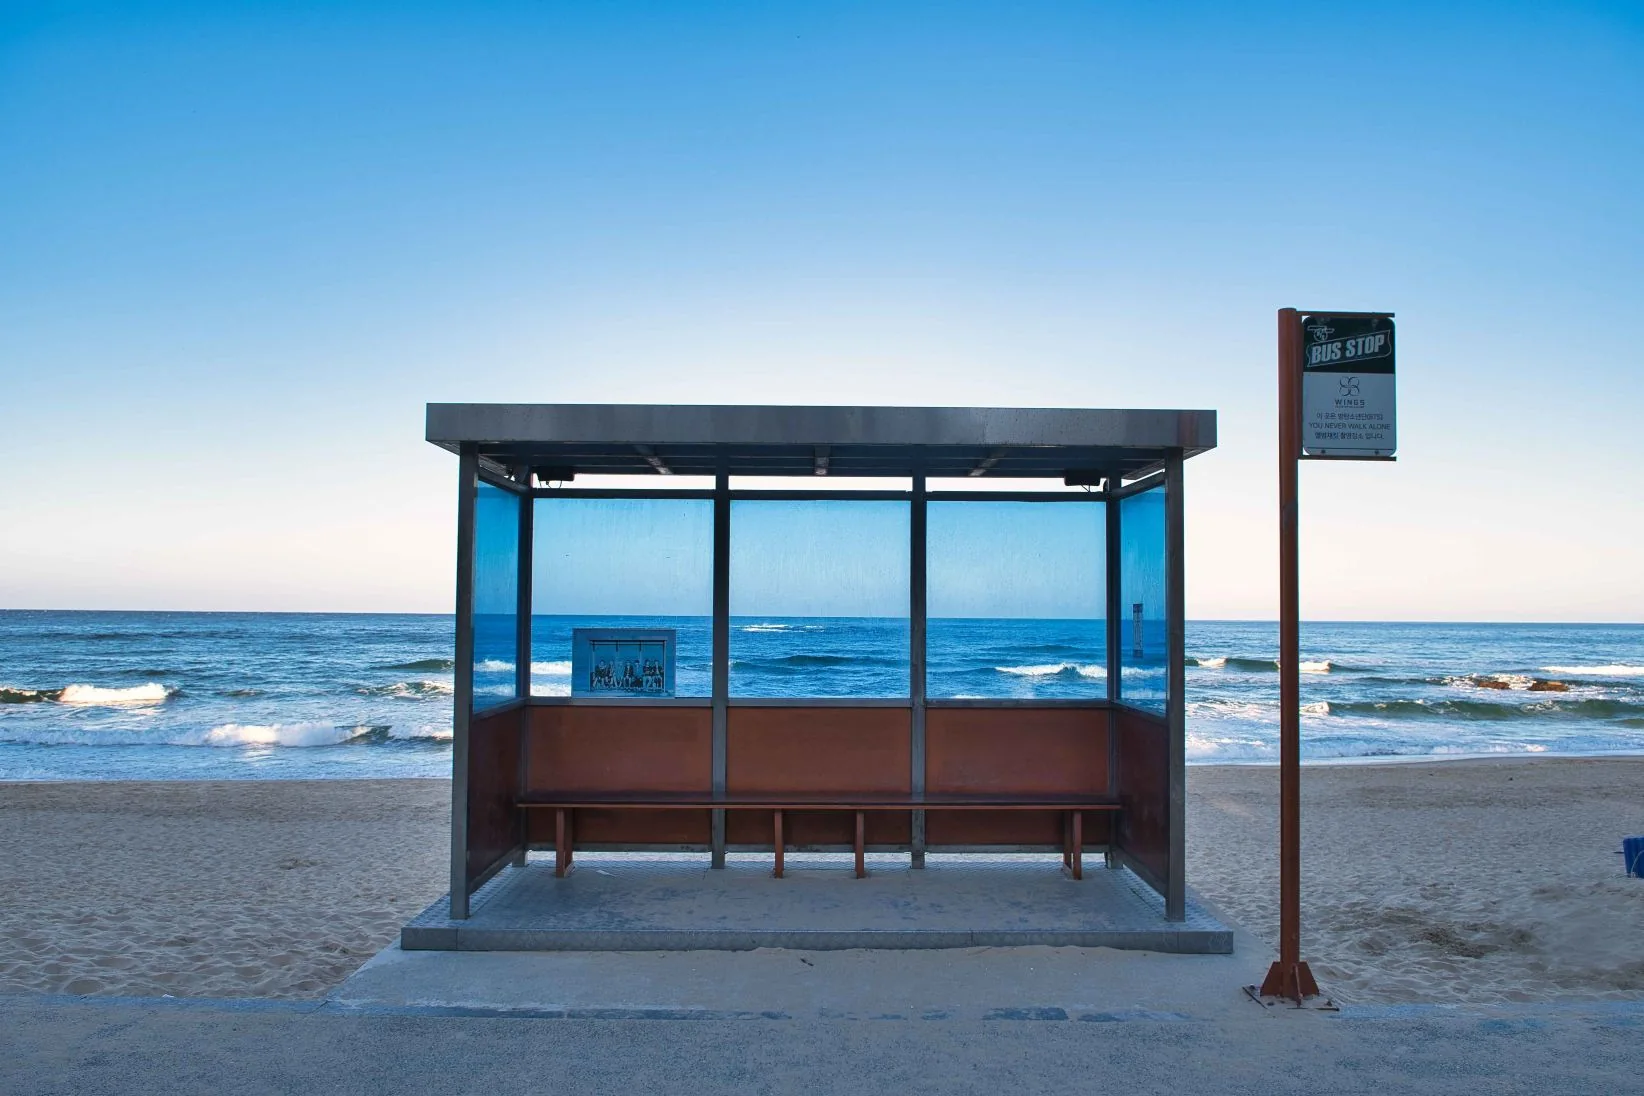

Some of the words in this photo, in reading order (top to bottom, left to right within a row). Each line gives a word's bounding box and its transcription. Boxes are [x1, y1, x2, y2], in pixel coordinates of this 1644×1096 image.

[1311, 342, 1342, 364] BUS
[1345, 334, 1385, 358] STOP
[1309, 422, 1323, 430] YOU
[1324, 422, 1347, 430] NEVER
[1368, 423, 1391, 431] ALONE
